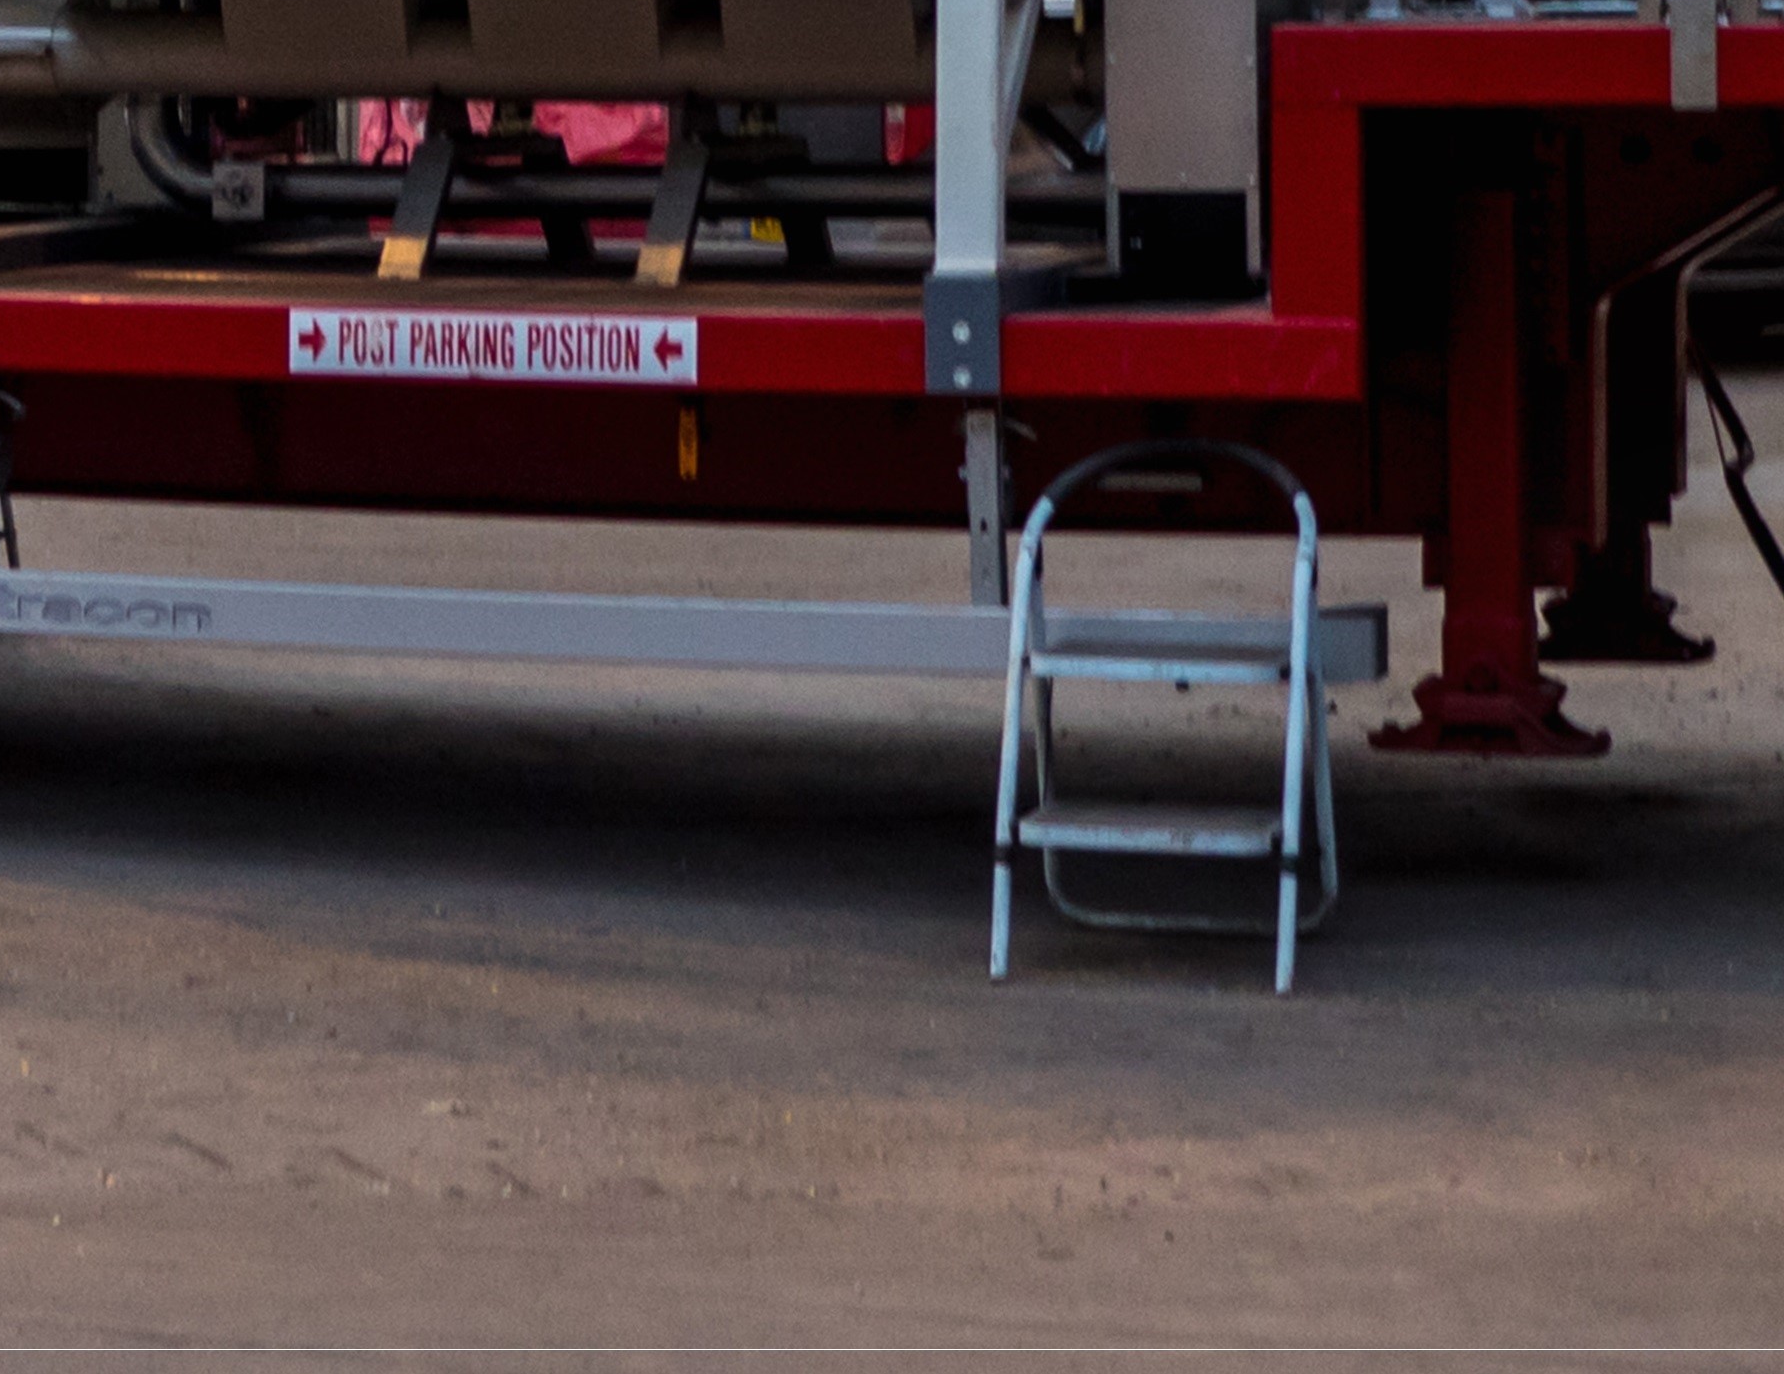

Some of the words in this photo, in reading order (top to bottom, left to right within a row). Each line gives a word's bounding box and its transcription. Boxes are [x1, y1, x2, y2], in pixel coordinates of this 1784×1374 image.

[338, 317, 399, 367] POST
[409, 320, 515, 371] PARKING
[527, 322, 641, 373] POSITION
